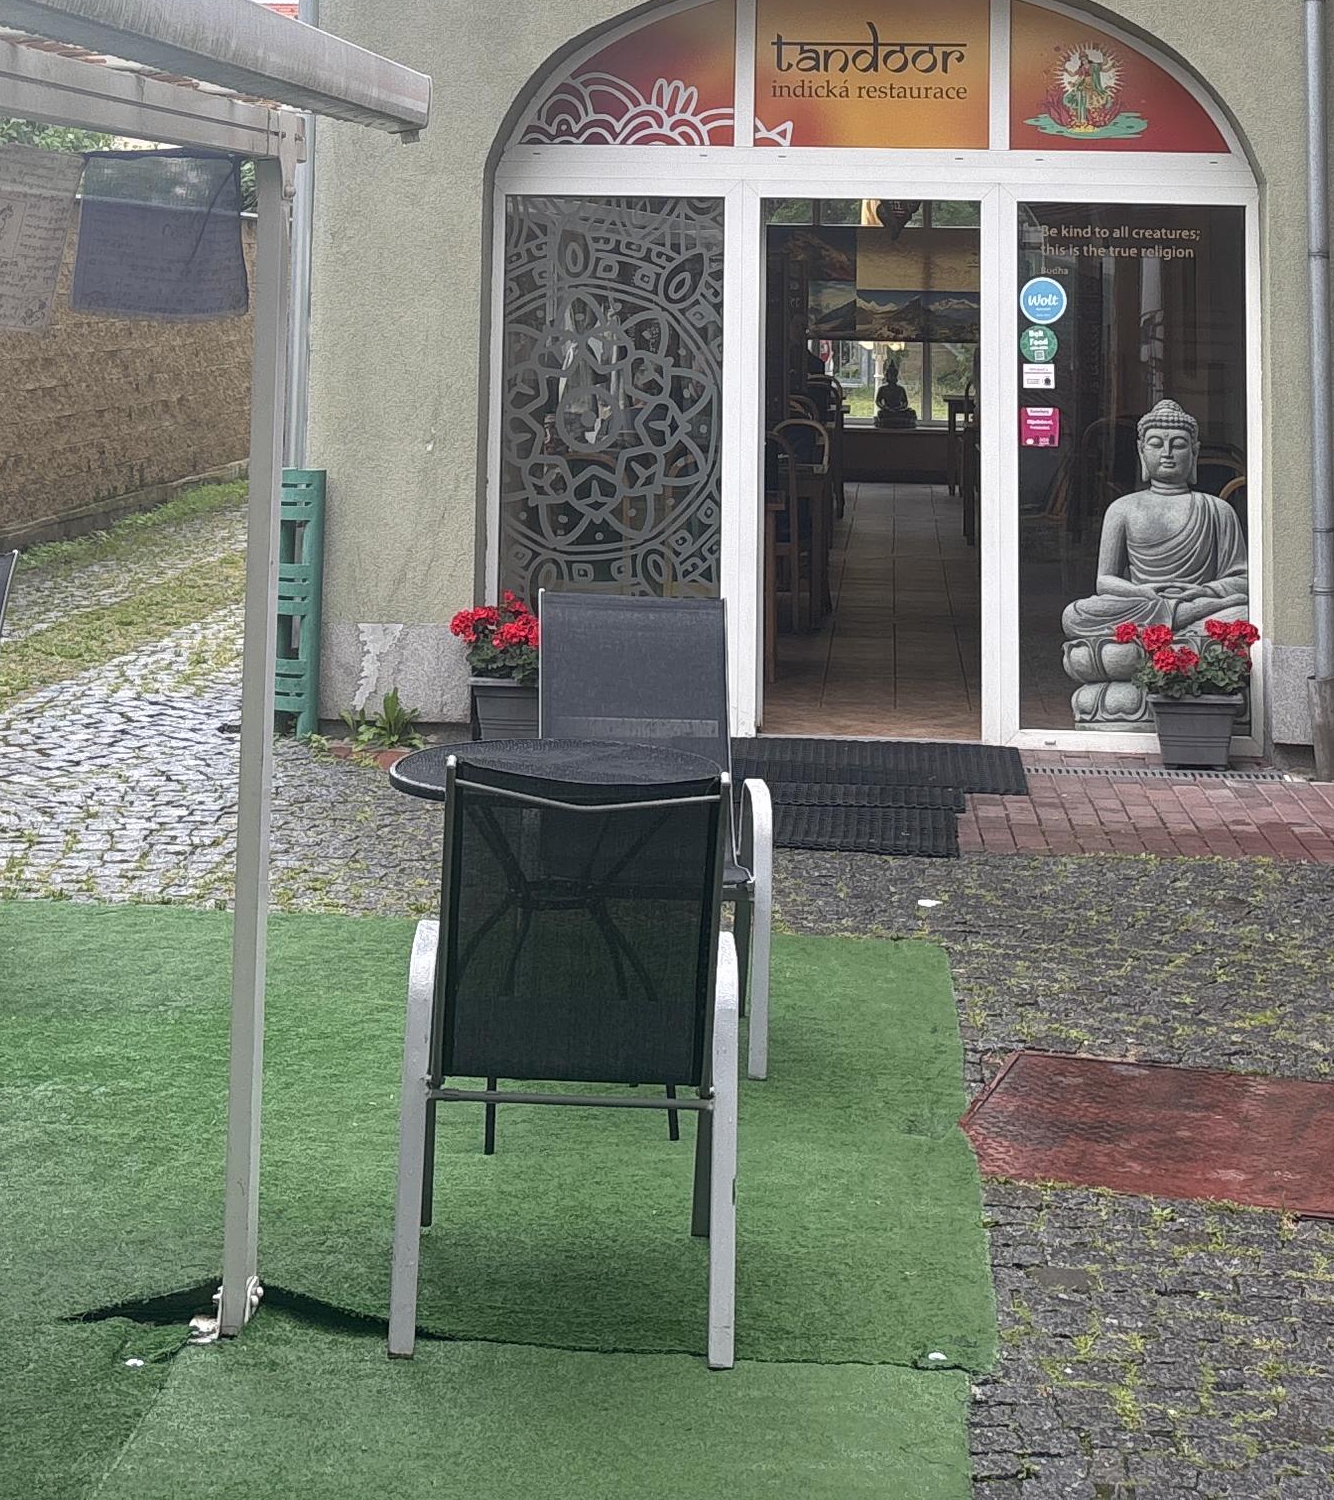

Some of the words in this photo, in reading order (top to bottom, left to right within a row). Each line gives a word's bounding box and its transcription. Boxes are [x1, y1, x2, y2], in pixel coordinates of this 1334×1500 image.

[771, 21, 967, 74] tandoor
[771, 79, 850, 99] indická
[857, 82, 967, 100] restaurace
[1041, 225, 1058, 237] Be
[1061, 224, 1092, 237] kind
[1094, 226, 1109, 238] to
[1112, 225, 1129, 238] all
[1132, 228, 1201, 241] creatures;
[1041, 243, 1067, 256] this
[1069, 243, 1080, 256] is
[1083, 243, 1106, 257] the
[1109, 245, 1138, 257] true
[1141, 244, 1194, 260] religion
[1028, 293, 1059, 307] Wolt
